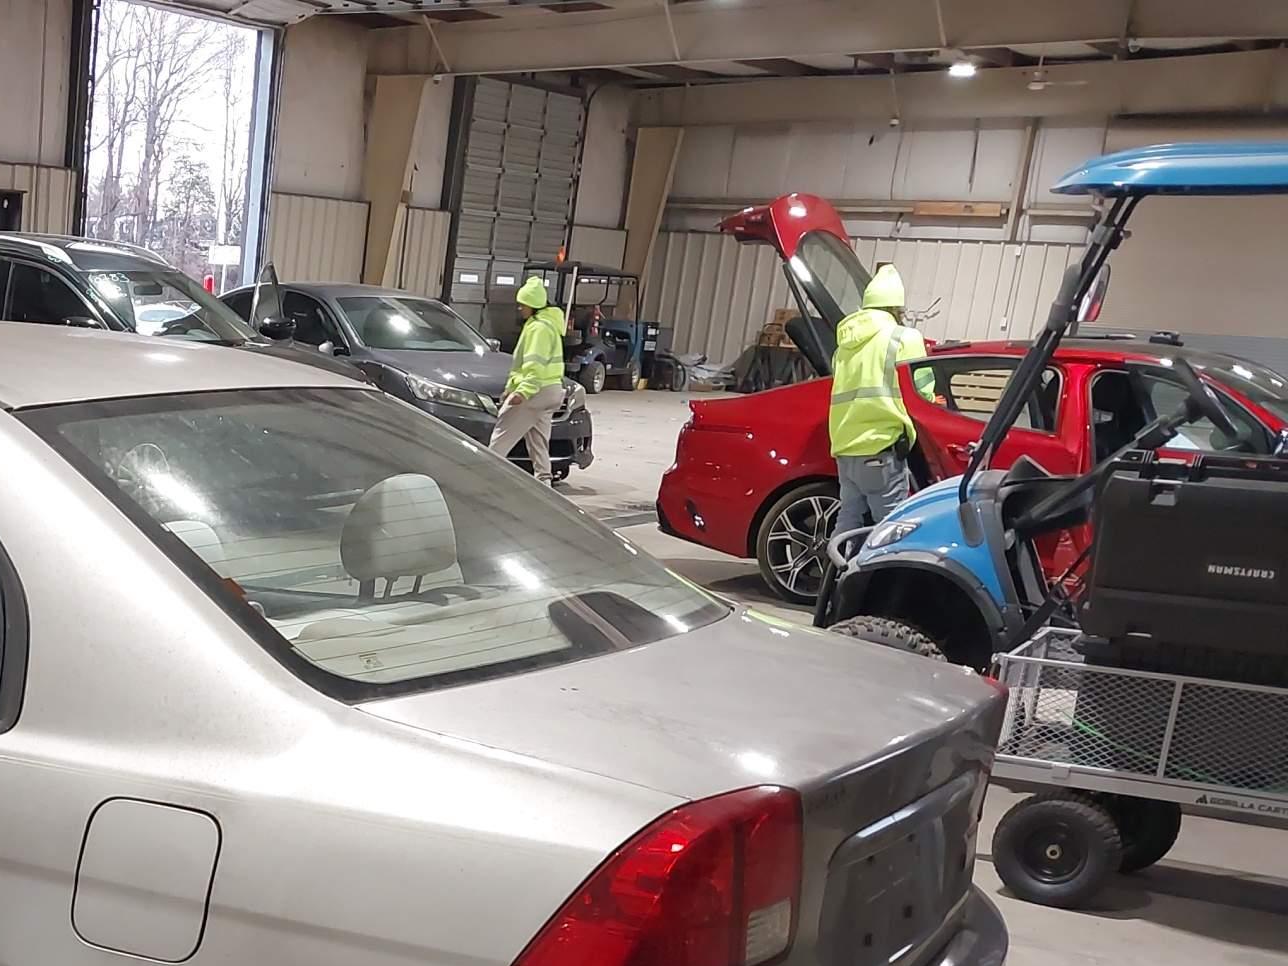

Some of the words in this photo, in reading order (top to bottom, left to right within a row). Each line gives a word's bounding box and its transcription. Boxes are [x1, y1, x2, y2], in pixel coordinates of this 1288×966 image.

[1207, 564, 1275, 579] CRAFTSMAN
[1209, 797, 1255, 810] GORILLA
[1258, 804, 1288, 816] CART
